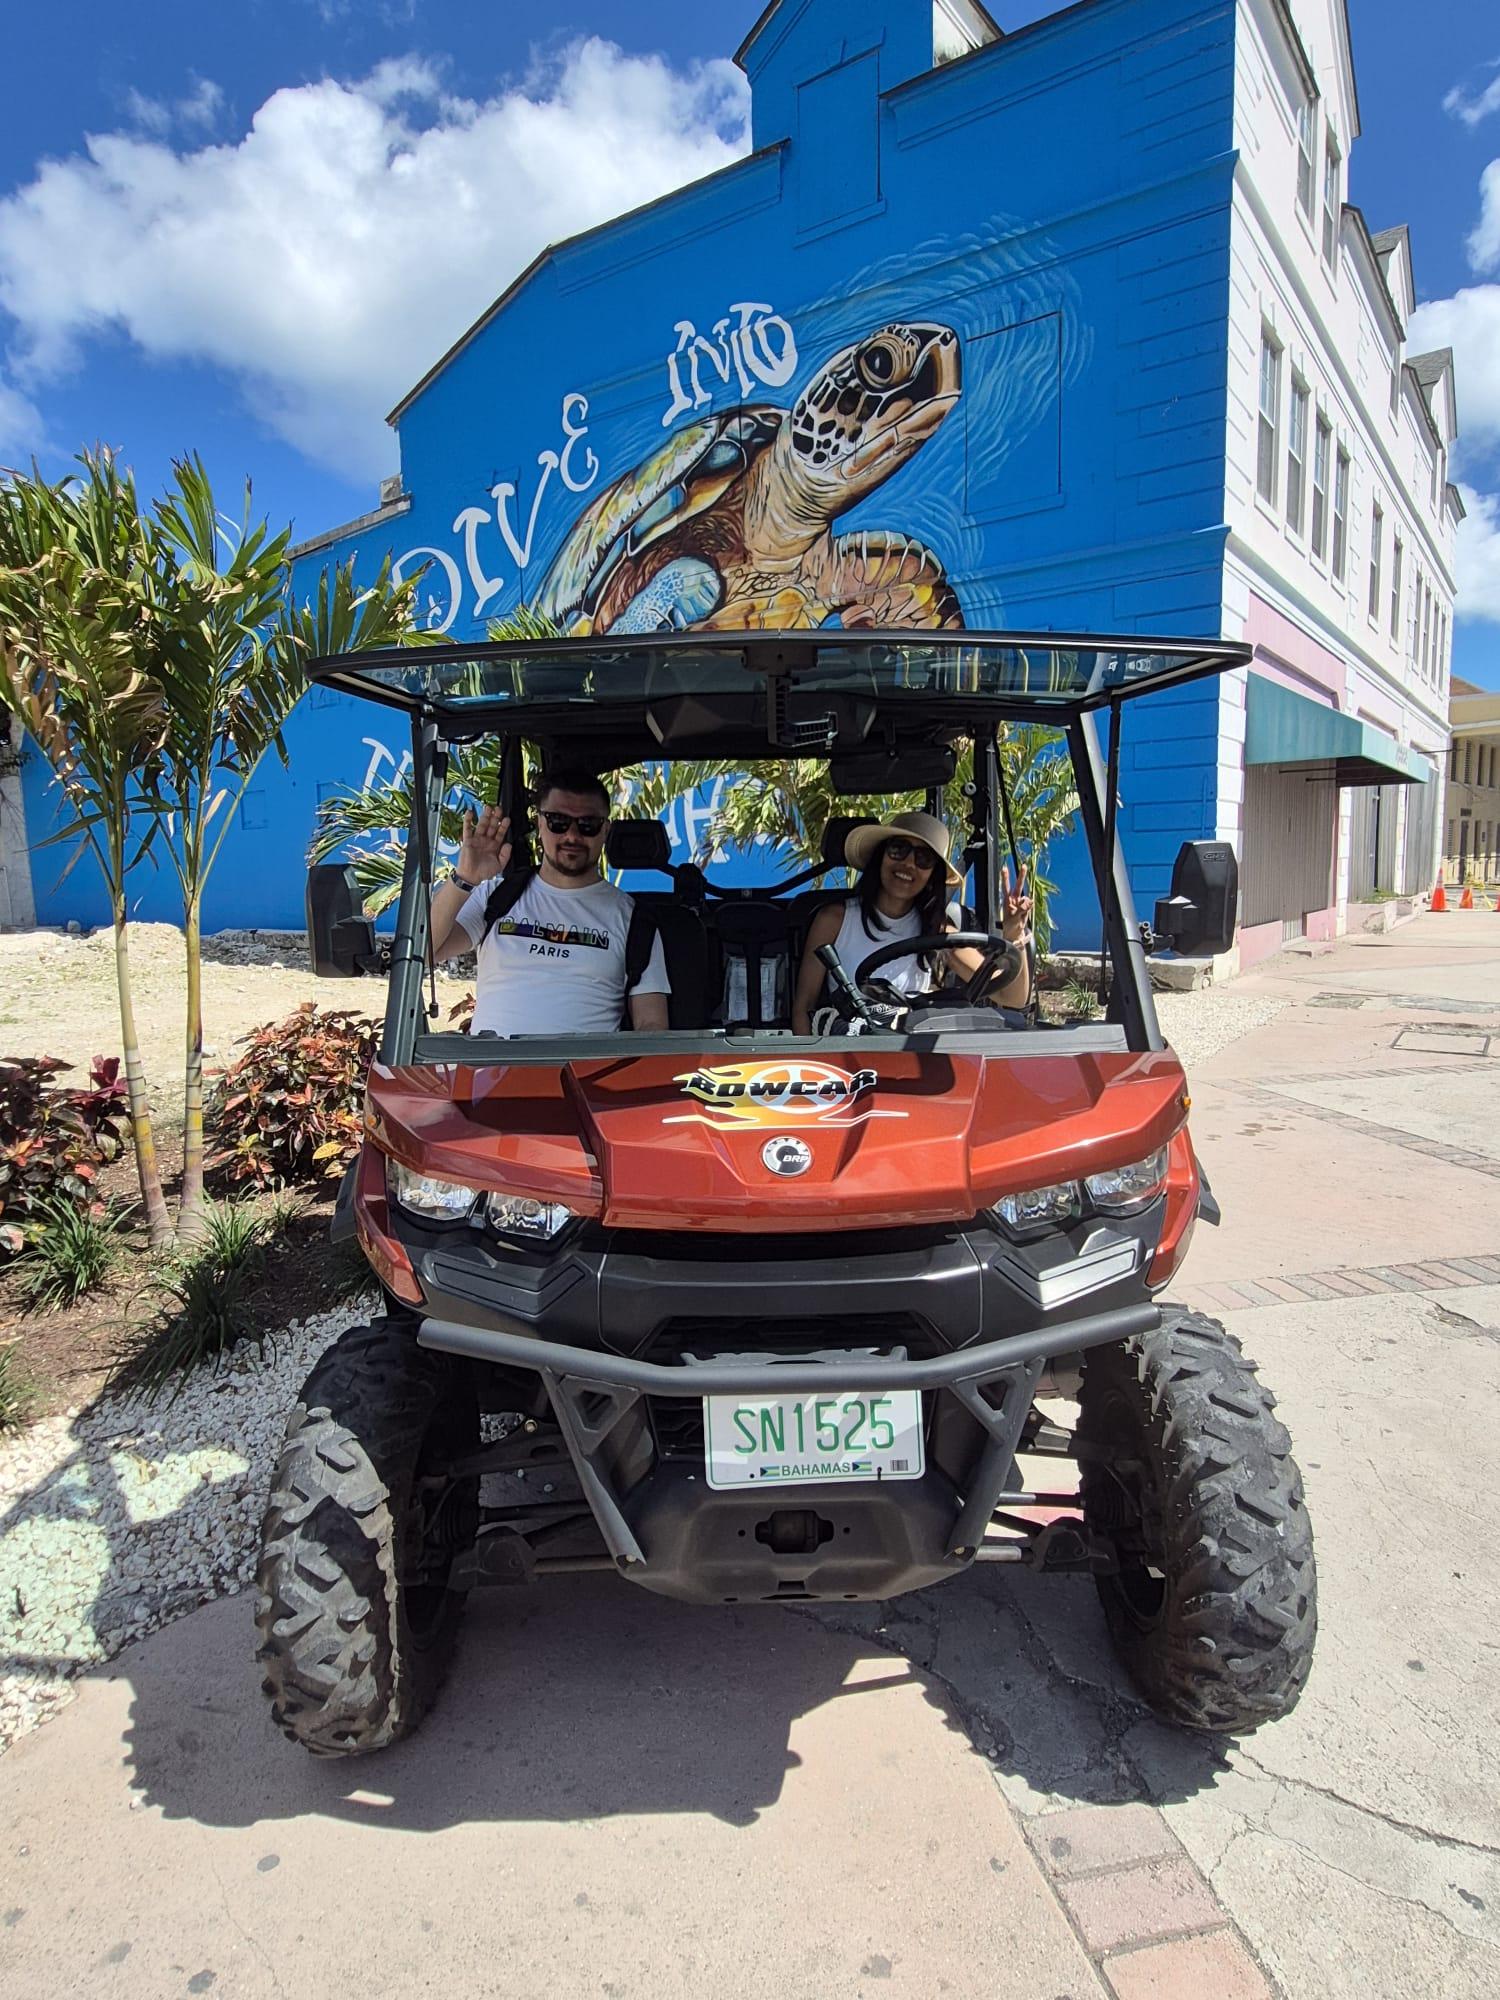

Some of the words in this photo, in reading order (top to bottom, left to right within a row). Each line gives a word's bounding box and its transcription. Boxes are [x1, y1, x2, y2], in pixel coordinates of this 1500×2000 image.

[391, 393, 599, 635] DIVE
[661, 302, 798, 427] INTO
[499, 915, 609, 948] BALMAIN
[528, 943, 570, 958] PARIS
[687, 1069, 878, 1098] BOWCAR
[782, 1154, 809, 1163] BRP
[732, 1399, 895, 1454] SN1525
[781, 1462, 850, 1477] BAHAMAS
